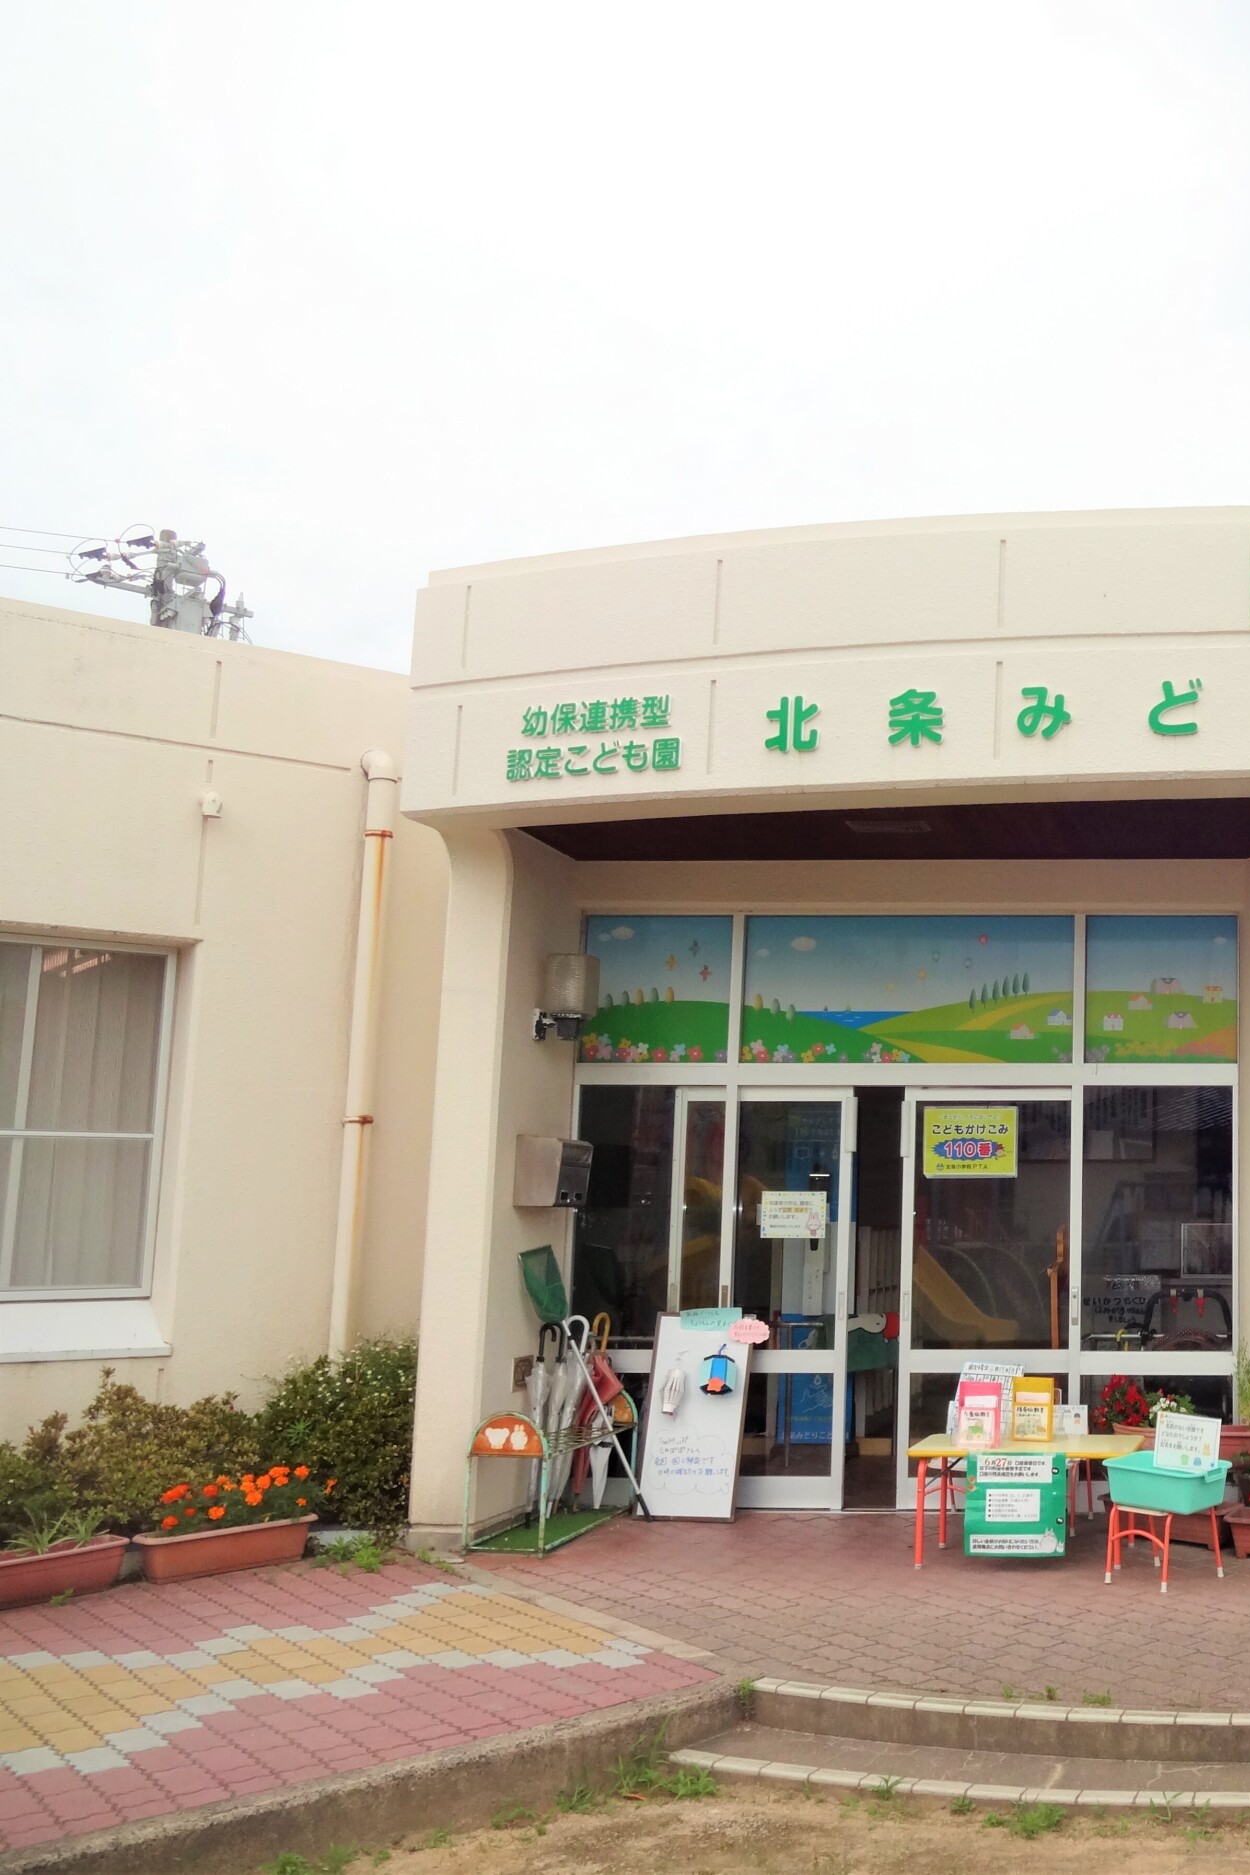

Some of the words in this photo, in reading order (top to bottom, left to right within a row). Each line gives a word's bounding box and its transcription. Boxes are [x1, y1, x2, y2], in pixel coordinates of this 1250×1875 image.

[522, 694, 670, 736] 幼保連携型
[506, 738, 681, 780] 認定こども園
[932, 1124, 1009, 1135] こどもかけこみ
[944, 1141, 993, 1157] 110番
